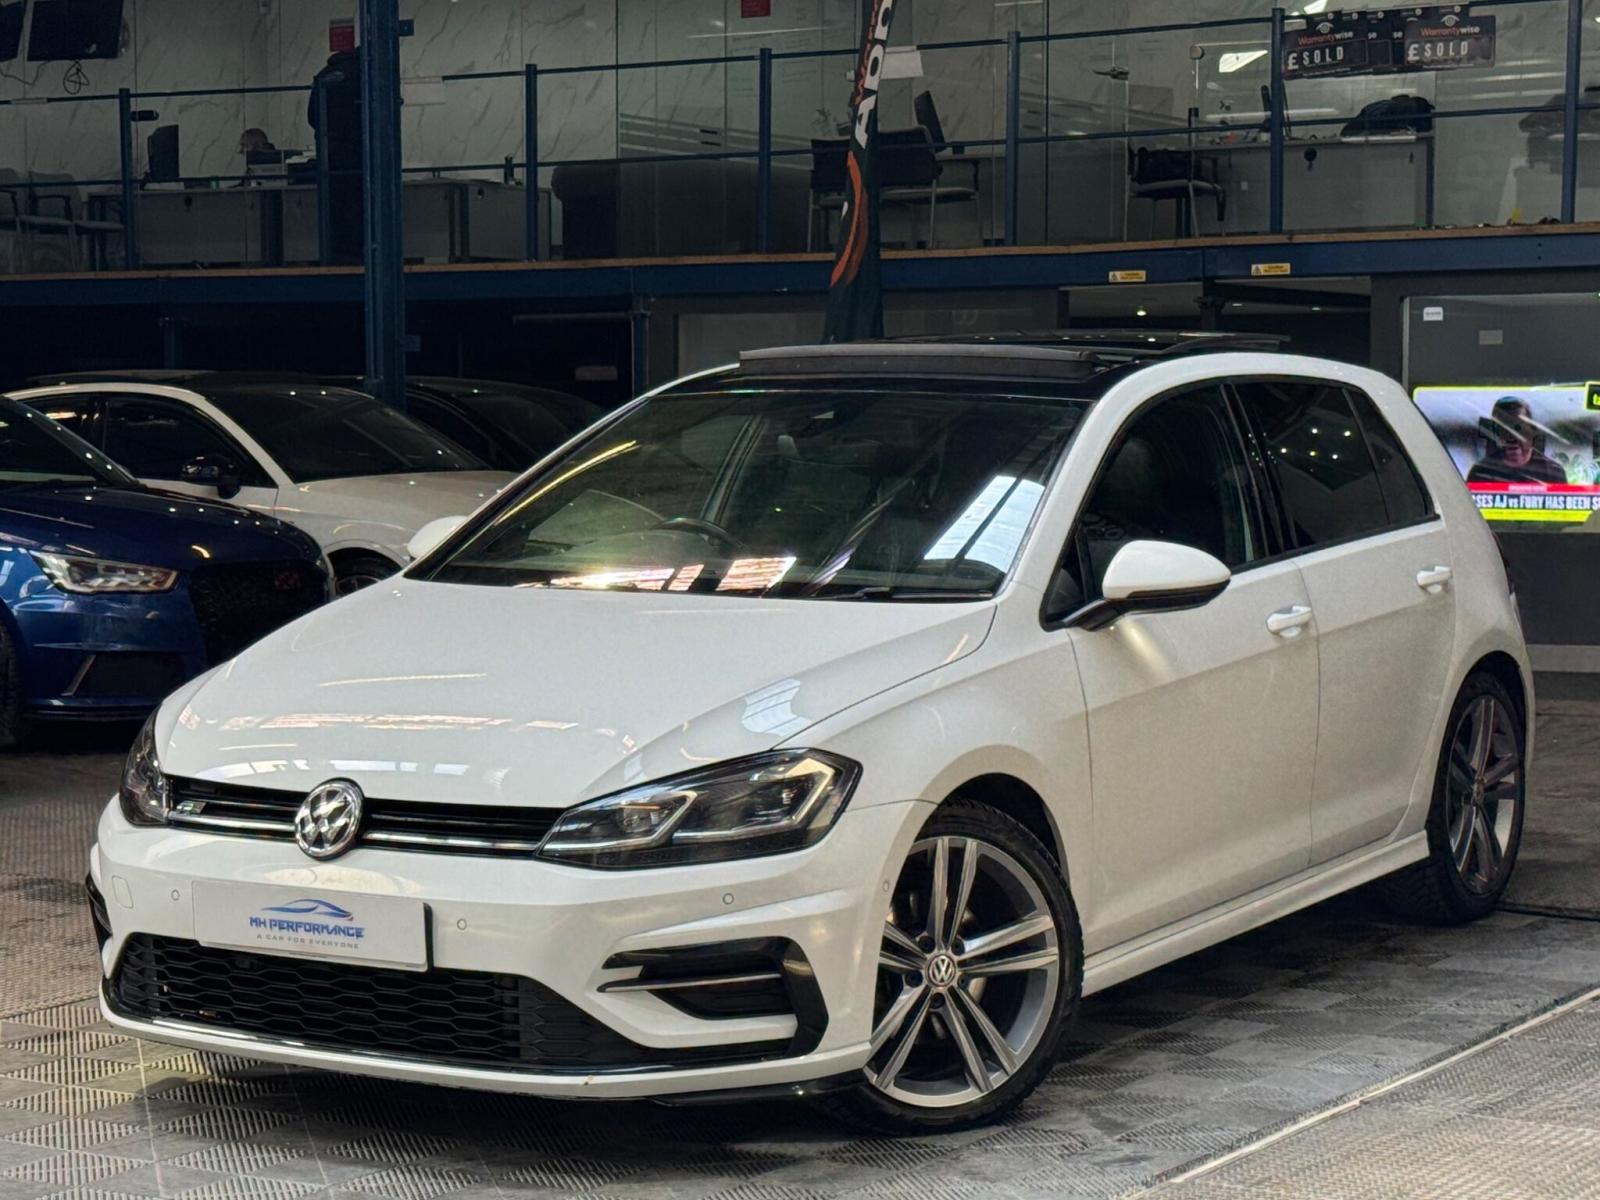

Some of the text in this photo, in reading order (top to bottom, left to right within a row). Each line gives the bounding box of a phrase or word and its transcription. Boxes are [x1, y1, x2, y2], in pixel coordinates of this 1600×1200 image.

[1298, 31, 1354, 46] Warrantywise
[1421, 26, 1480, 37] Warrantywise
[1302, 46, 1344, 65] SOLD
[1424, 41, 1469, 57] SOLD
[1494, 495, 1507, 508] AJ
[1520, 495, 1544, 508] FURY
[1545, 496, 1564, 509] HAS
[1566, 496, 1590, 509] BEEN
[249, 917, 365, 938] MH PERFORMANCE
[309, 939, 359, 949] EVERYONE
